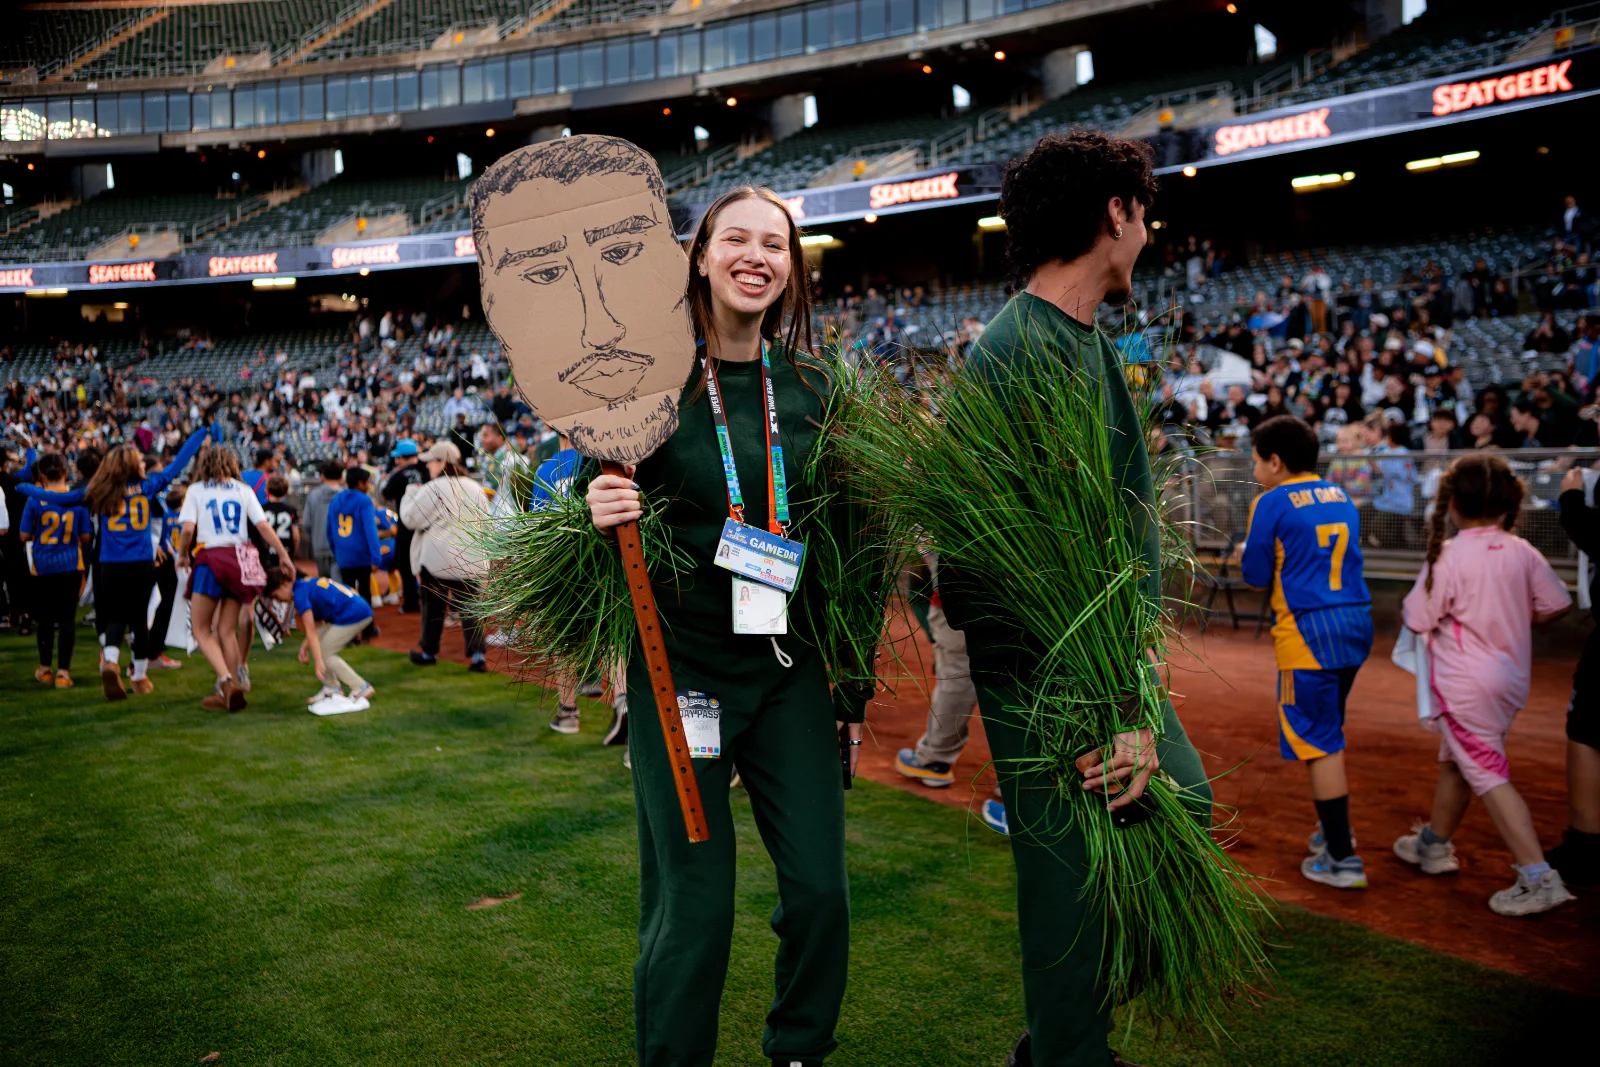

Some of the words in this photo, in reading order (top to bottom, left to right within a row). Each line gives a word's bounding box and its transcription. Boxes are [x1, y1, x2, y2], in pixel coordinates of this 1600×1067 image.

[1432, 59, 1574, 116] SEATGEEK
[1214, 107, 1331, 156] SEATGEEK
[869, 172, 959, 209] SEATGEEK
[208, 252, 278, 277] SEATGEEK
[331, 243, 400, 269] SEATGEEK
[89, 261, 156, 284] SEATGEEK
[707, 379, 718, 396] BOWL
[711, 396, 722, 414] SUPER
[767, 394, 775, 411] BOWL
[769, 411, 779, 434] LX
[107, 496, 149, 531] 20
[206, 499, 242, 535] 19
[40, 511, 74, 545] 21
[749, 537, 800, 562] GAMEDAY
[1315, 523, 1349, 591] 7
[697, 709, 719, 719] PASS
